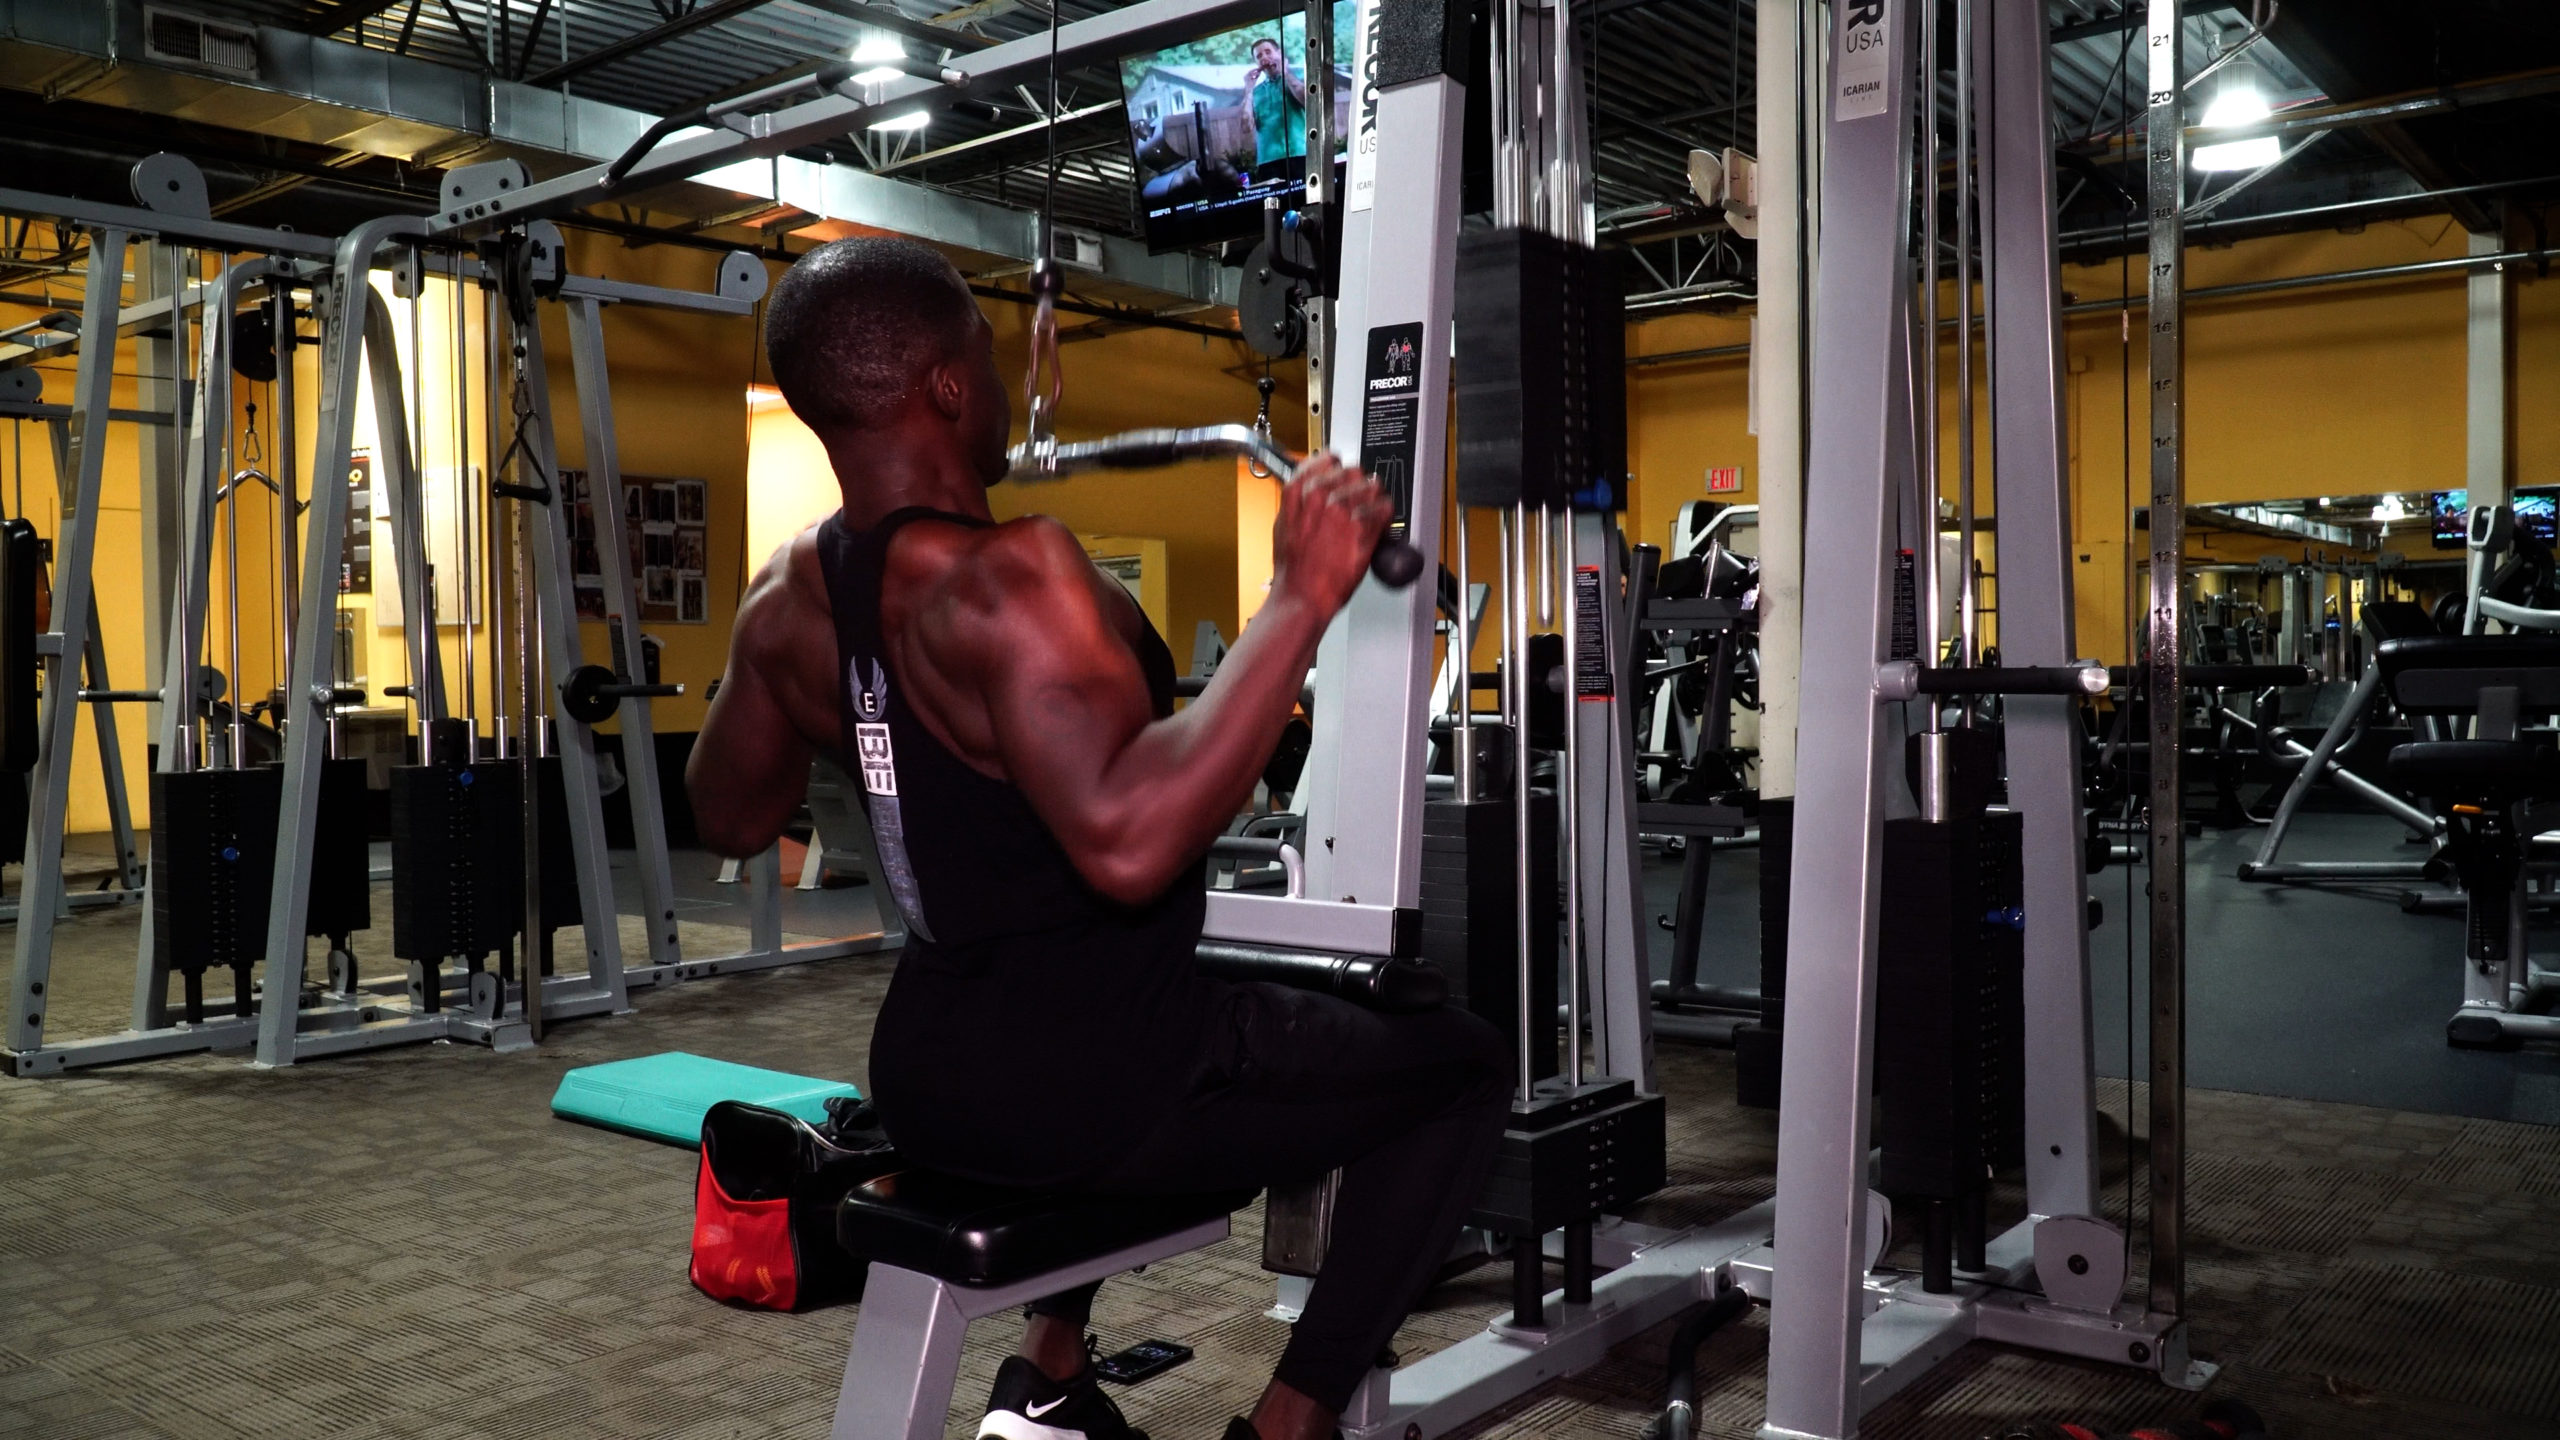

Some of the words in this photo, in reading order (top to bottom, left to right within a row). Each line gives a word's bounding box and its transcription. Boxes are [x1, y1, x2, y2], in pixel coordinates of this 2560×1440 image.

[1846, 29, 1884, 54] USA
[2152, 34, 2170, 47] 21
[1843, 81, 1880, 97] ICARIAN
[2151, 90, 2172, 104] 20
[1359, 137, 1377, 155] US
[2152, 150, 2171, 162] 19
[2152, 207, 2172, 219] 18
[2153, 264, 2172, 277] 17
[2154, 322, 2171, 333] 16
[1369, 375, 1408, 391] PRECOR
[2154, 379, 2172, 392] 15
[2154, 436, 2171, 449] 14
[1711, 467, 1737, 490] EXIT
[2154, 494, 2172, 505] 13
[2154, 551, 2171, 562] 12
[2154, 607, 2172, 621] 11
[864, 692, 876, 714] E
